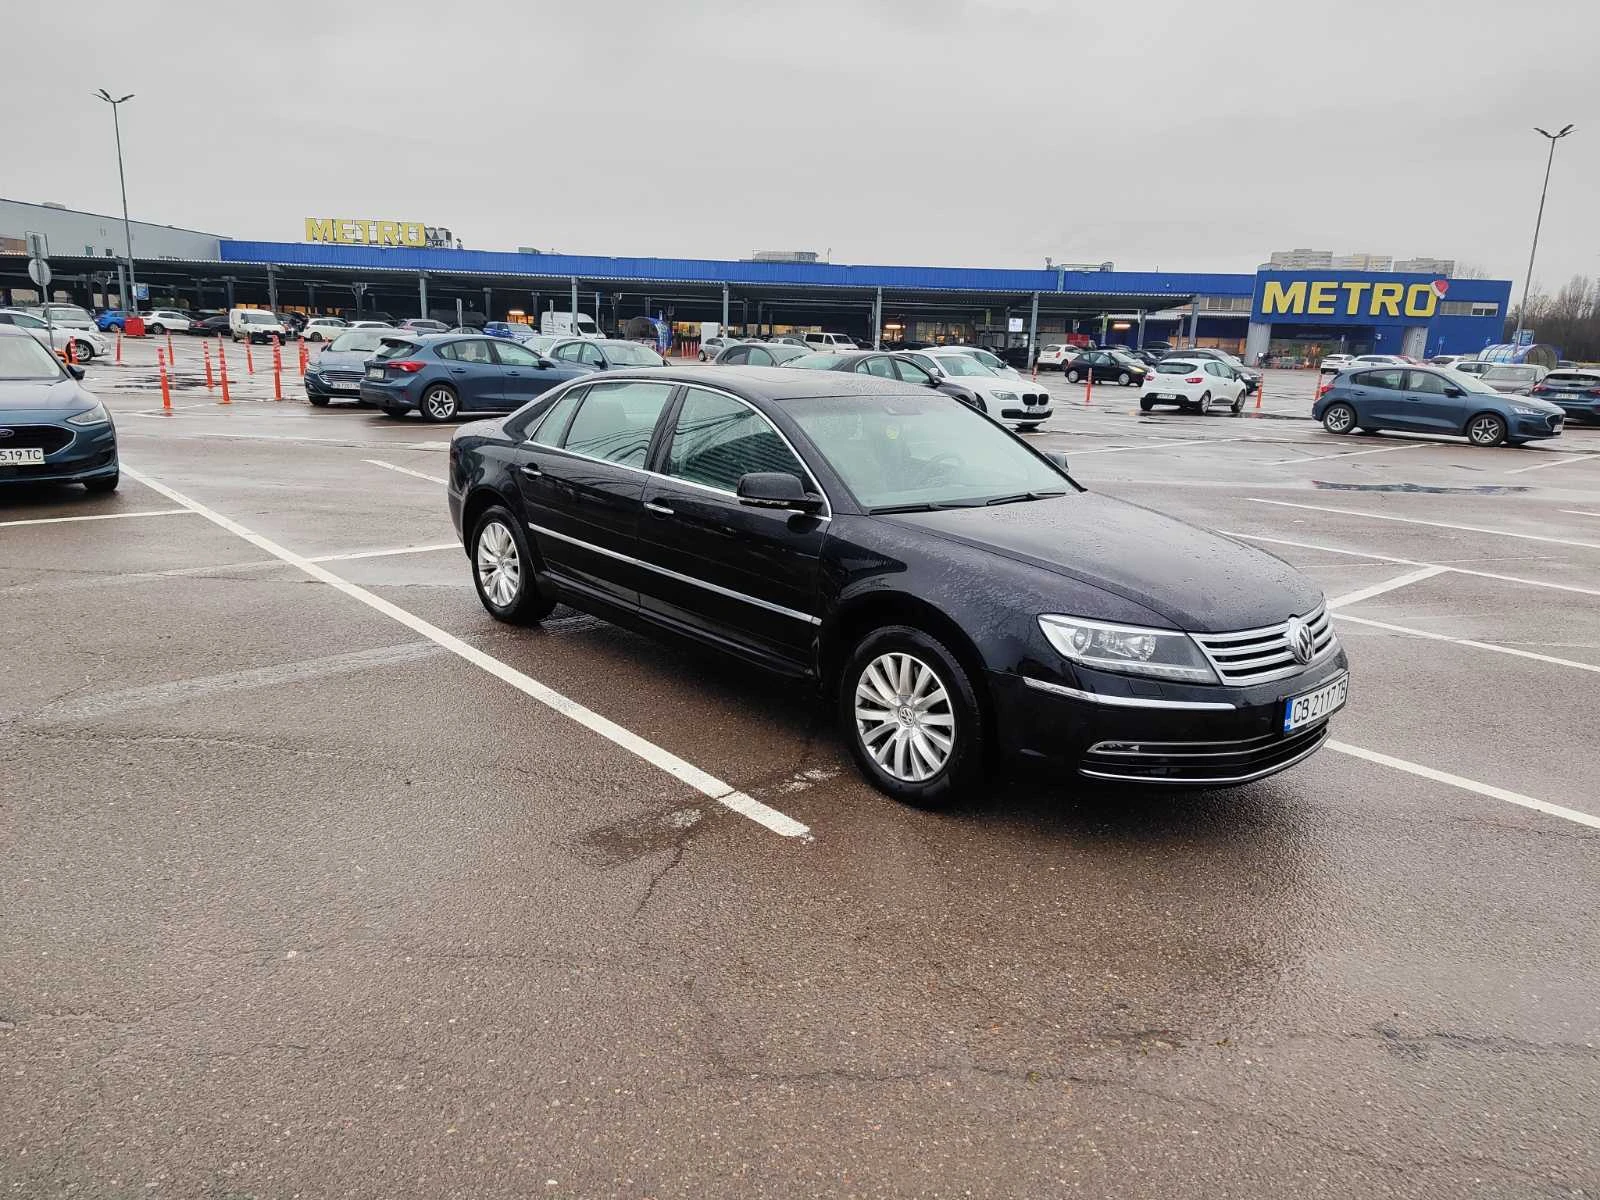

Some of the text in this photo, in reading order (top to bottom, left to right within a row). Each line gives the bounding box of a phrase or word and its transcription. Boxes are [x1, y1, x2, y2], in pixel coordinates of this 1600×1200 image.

[305, 217, 426, 247] METRO
[1262, 281, 1438, 317] METRO
[24, 450, 41, 460] TC
[1293, 698, 1310, 723] CB
[1312, 685, 1336, 716] 2117
